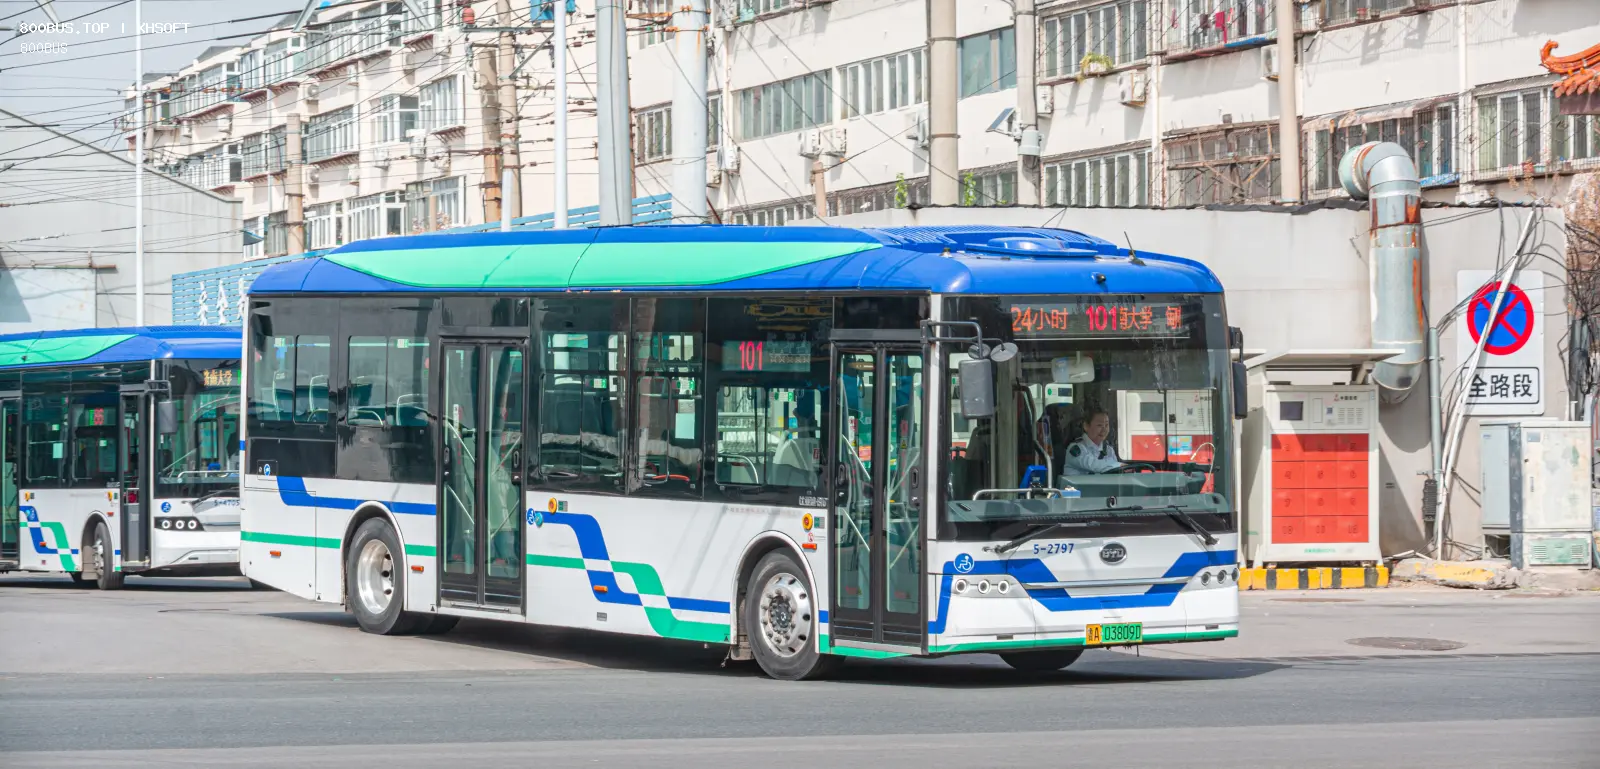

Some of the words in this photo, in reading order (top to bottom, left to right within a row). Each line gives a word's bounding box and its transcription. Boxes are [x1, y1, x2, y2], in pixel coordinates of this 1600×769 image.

[1011, 306, 1068, 331] 24小时
[1085, 306, 1117, 330] 101
[739, 341, 763, 370] 101
[1468, 374, 1532, 398] 全路段
[1033, 543, 1074, 554] 5-2797
